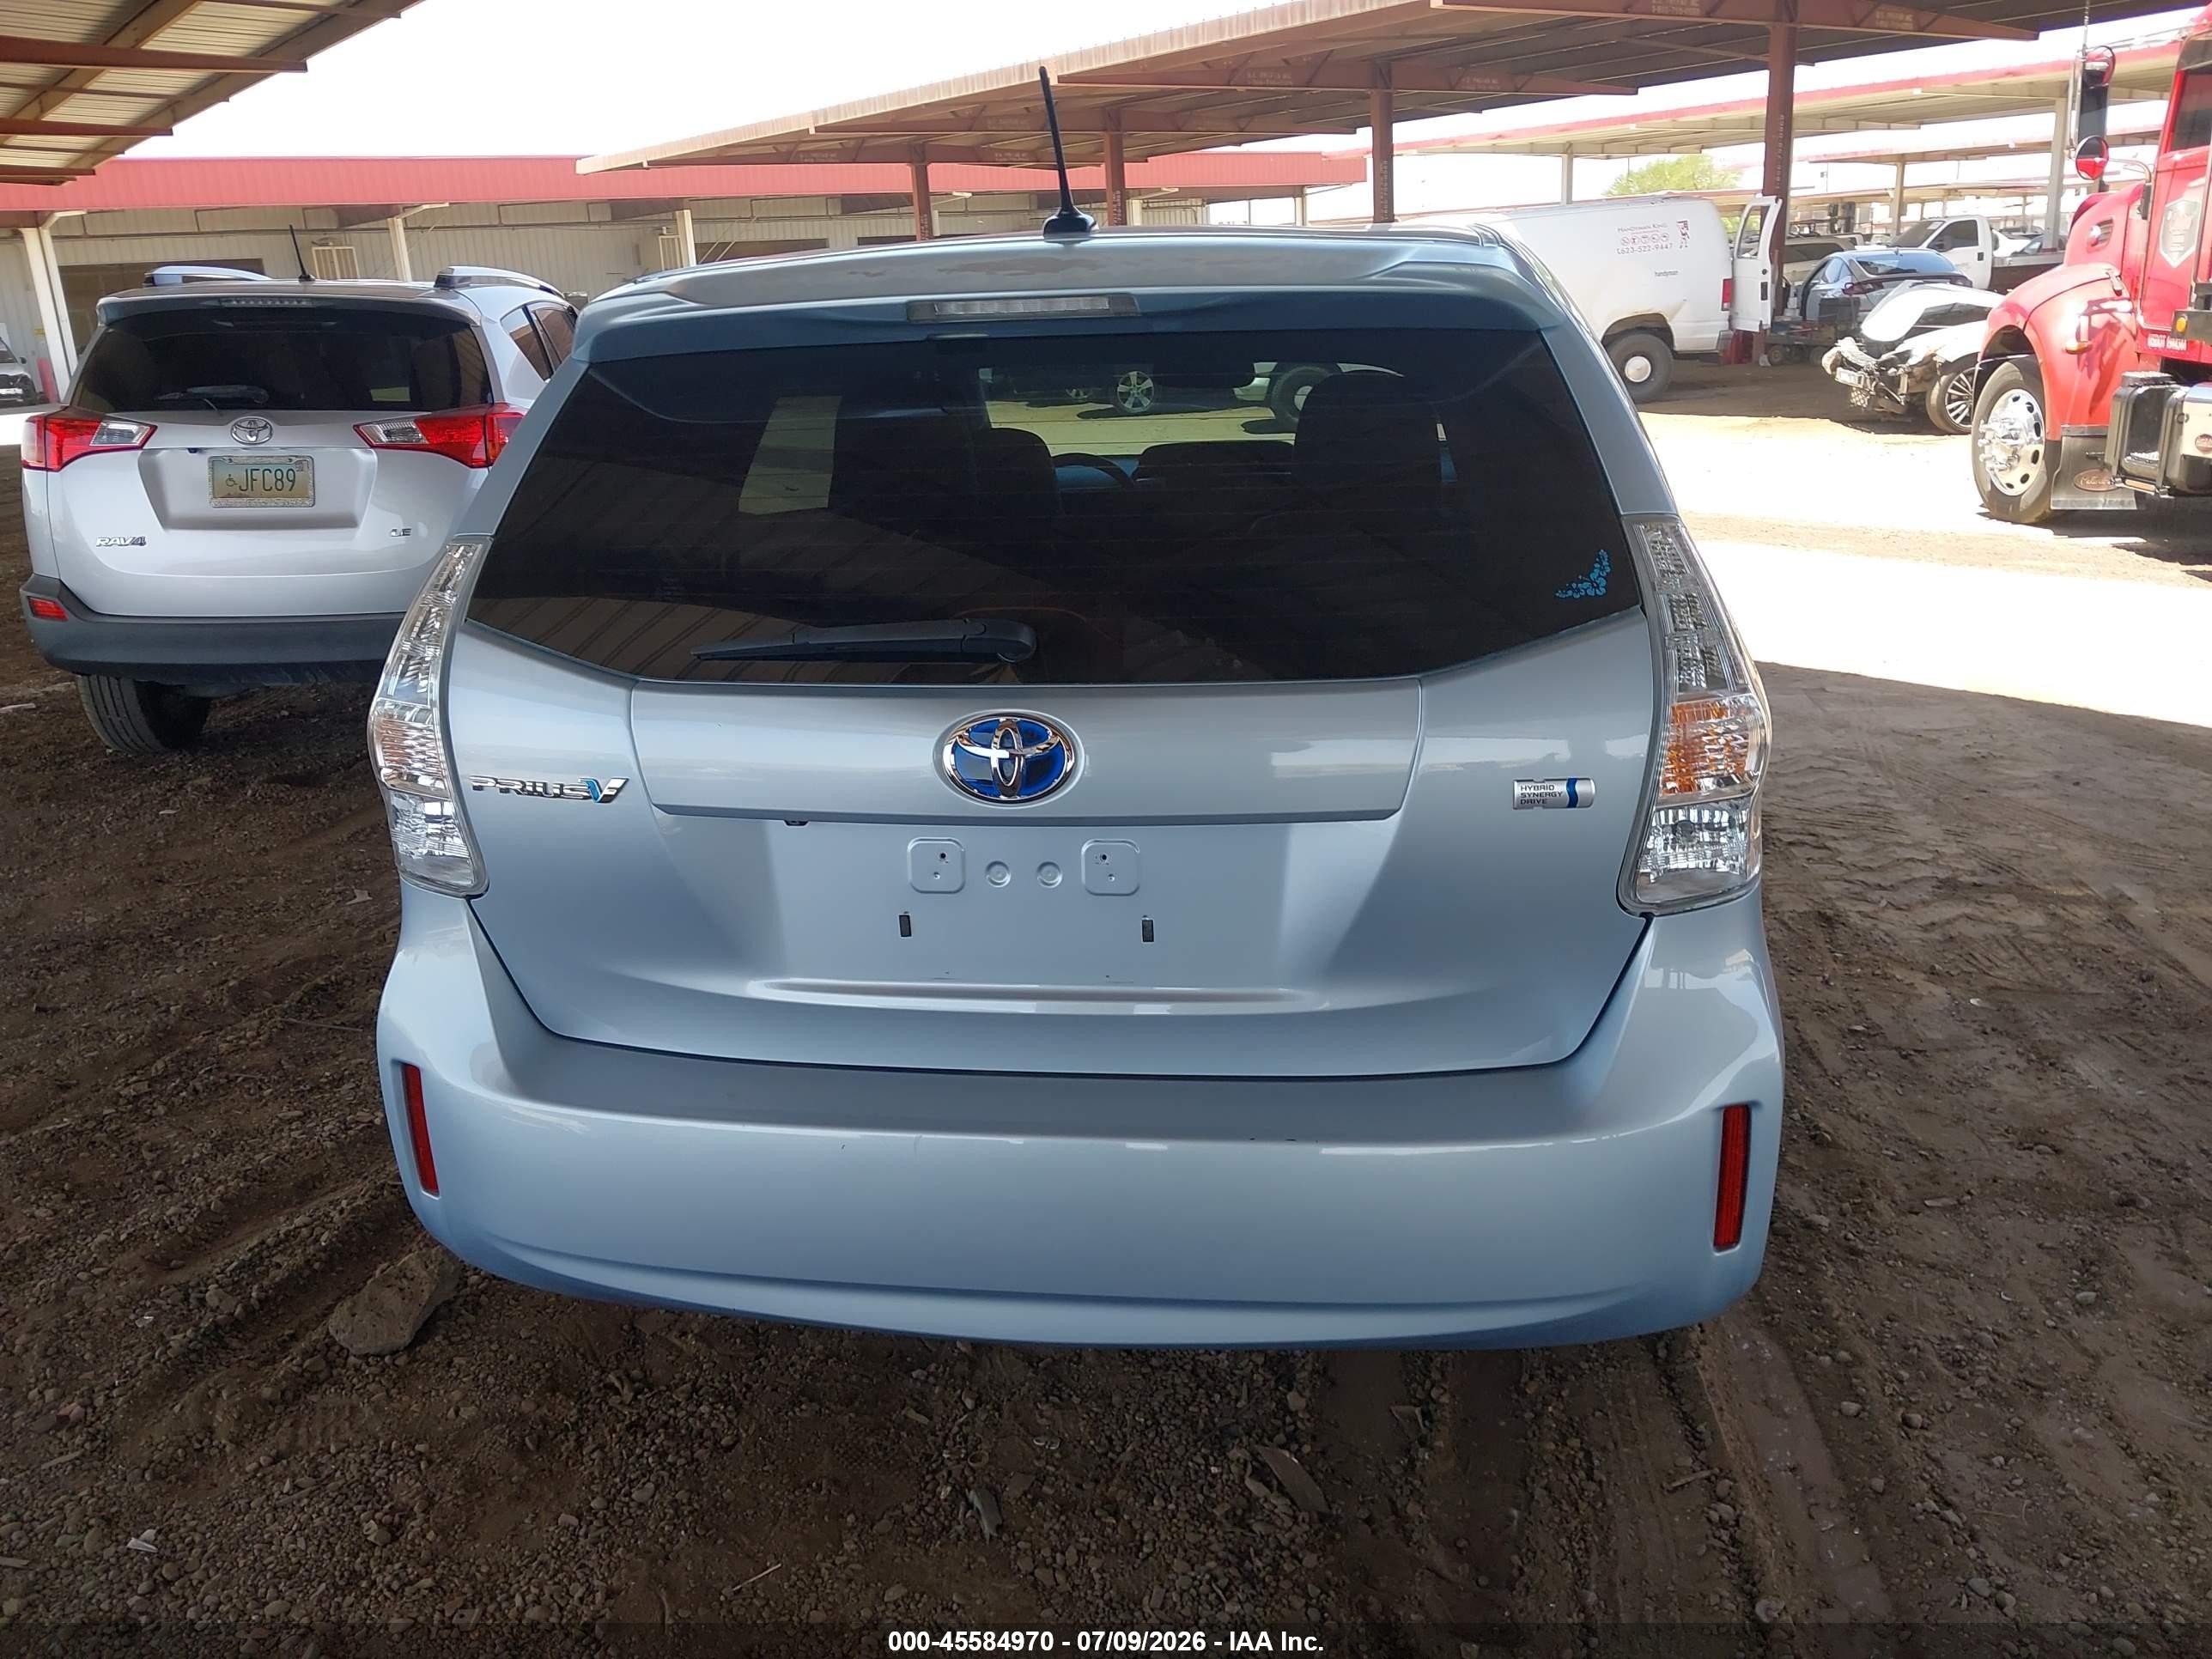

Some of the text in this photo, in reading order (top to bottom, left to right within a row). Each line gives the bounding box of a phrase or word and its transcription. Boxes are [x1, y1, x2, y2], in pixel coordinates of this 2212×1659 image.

[239, 468, 296, 492] JFC89
[391, 528, 413, 538] LE
[95, 536, 146, 547] RAV4
[469, 775, 592, 800] PRIUS
[1520, 783, 1554, 792] HYBRID
